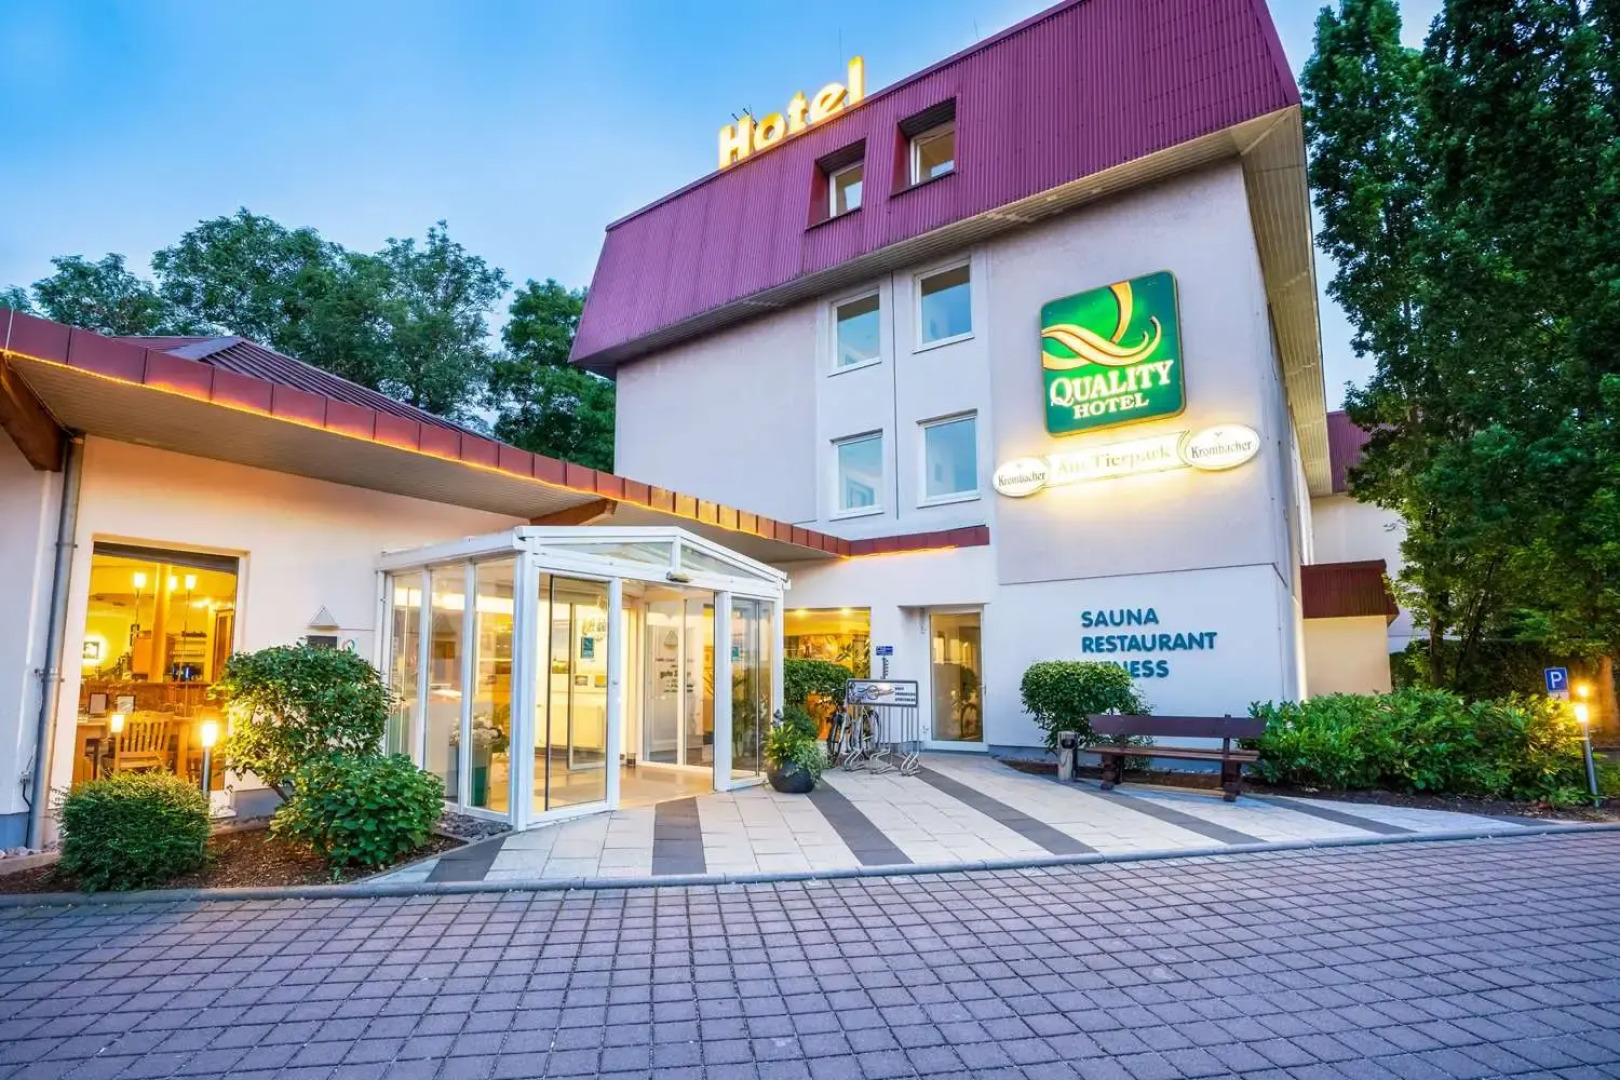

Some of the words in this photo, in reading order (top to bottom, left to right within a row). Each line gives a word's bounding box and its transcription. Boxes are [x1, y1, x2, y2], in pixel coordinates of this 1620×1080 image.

[718, 55, 865, 170] Hotel
[1050, 359, 1174, 407] QUALITY
[1073, 393, 1150, 419] HOTEL
[1191, 440, 1252, 458] Krombacher
[1057, 459, 1086, 475] Am
[1091, 445, 1171, 470] Tierpark
[998, 471, 1046, 487] Krombacher
[1081, 608, 1159, 628] SAUNA
[1081, 632, 1217, 653] RESTAURANT
[1550, 671, 1563, 689] P
